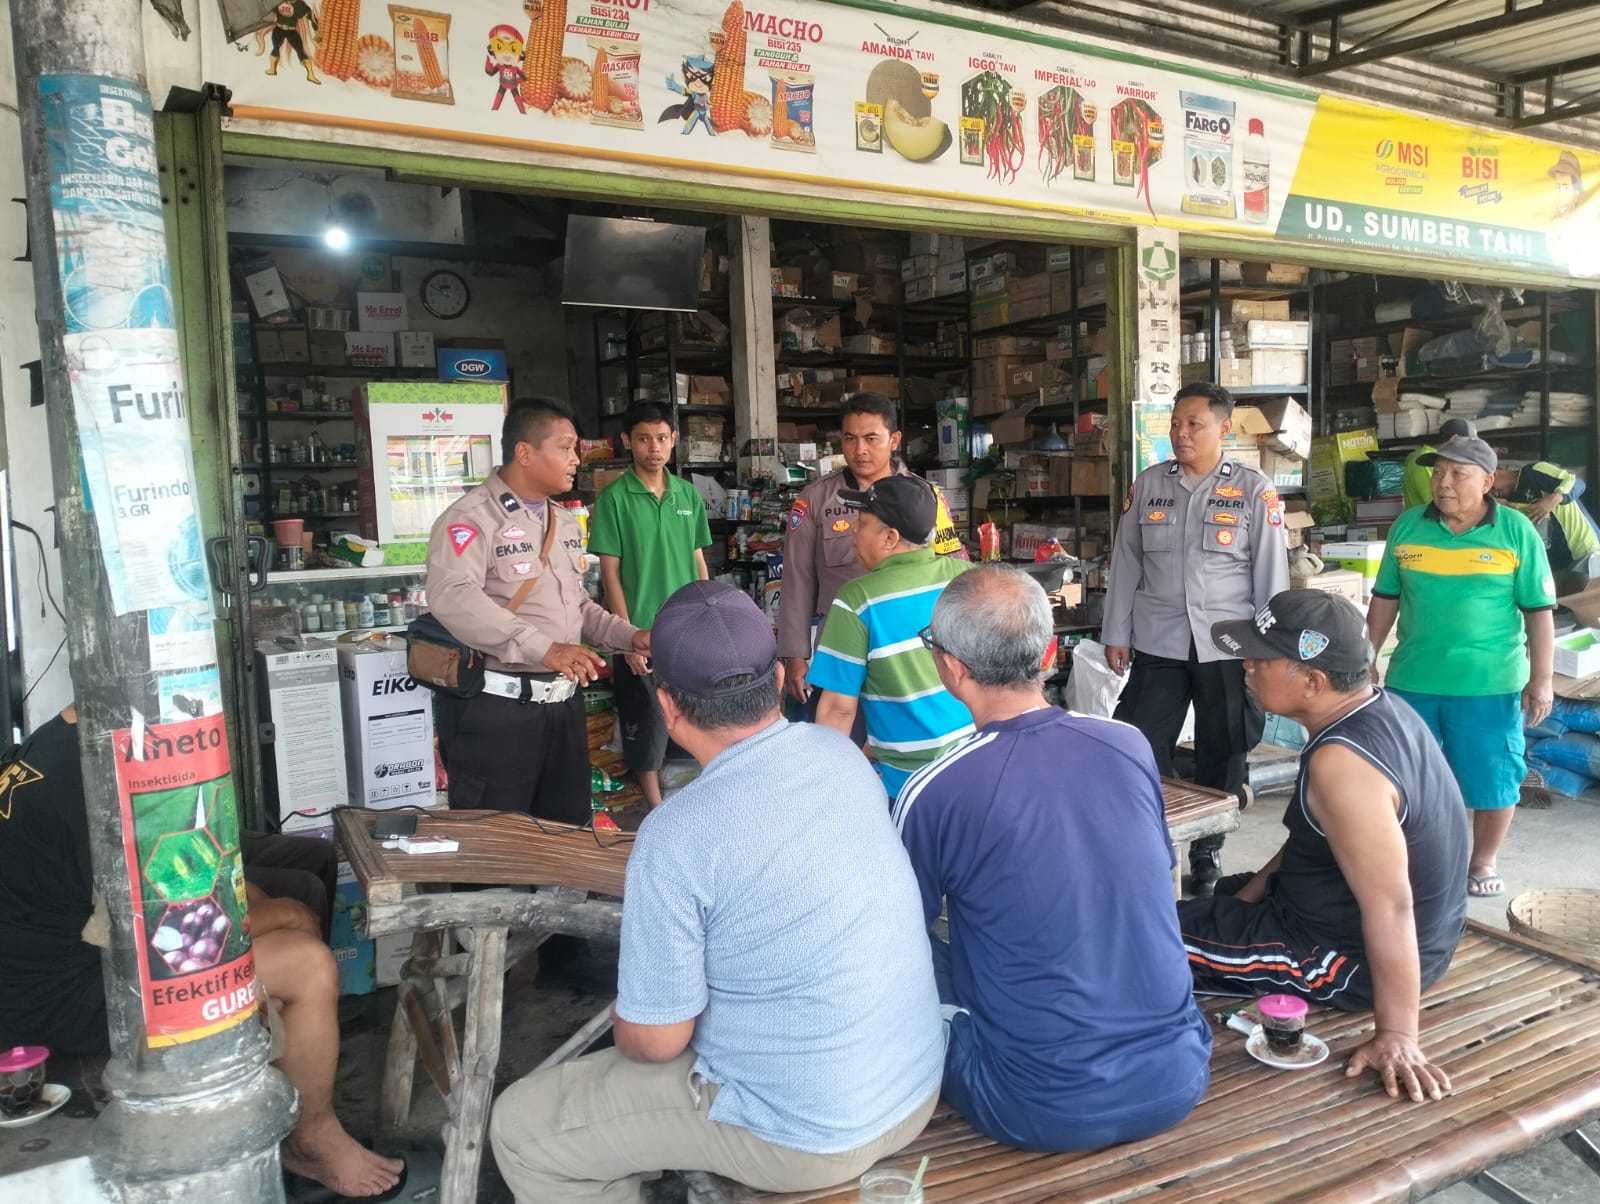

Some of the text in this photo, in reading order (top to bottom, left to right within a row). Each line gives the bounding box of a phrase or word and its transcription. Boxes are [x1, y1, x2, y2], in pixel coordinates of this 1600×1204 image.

[579, 17, 602, 26] TAHAN
[744, 11, 823, 43] MACHO
[568, 26, 601, 35] KEMARAU
[623, 33, 638, 41] OKE
[786, 42, 801, 53] 235
[862, 41, 935, 61] AMANDA TAVI
[756, 49, 799, 62] TANGGUH &
[601, 60, 639, 73] MASKOT
[760, 60, 809, 72] TAHAN BULAI
[968, 57, 1017, 72] IGGO TAVI
[1034, 69, 1096, 88] IMPERIAL IJO
[1116, 85, 1156, 100] WARRIOR
[1185, 110, 1231, 135] FARGO
[1398, 142, 1429, 168] MSI
[1462, 156, 1499, 180] BISI
[1305, 203, 1351, 233] UD.
[1364, 211, 1471, 249] SUMBER
[1479, 229, 1532, 257] TANI
[461, 363, 484, 372] DGW
[114, 478, 190, 504] Furindo
[1148, 499, 1174, 507] ARIS
[1208, 499, 1244, 509] POLRI
[118, 504, 151, 518] 3 GR
[496, 542, 534, 557] EKA.SH
[563, 538, 582, 550] POL
[1219, 634, 1242, 651] POLICE
[372, 677, 419, 696] EIKO
[387, 759, 425, 773] DRAGON
[128, 771, 196, 789] Insektisida
[152, 971, 228, 1006] Efektif
[202, 976, 257, 1021] GURE
